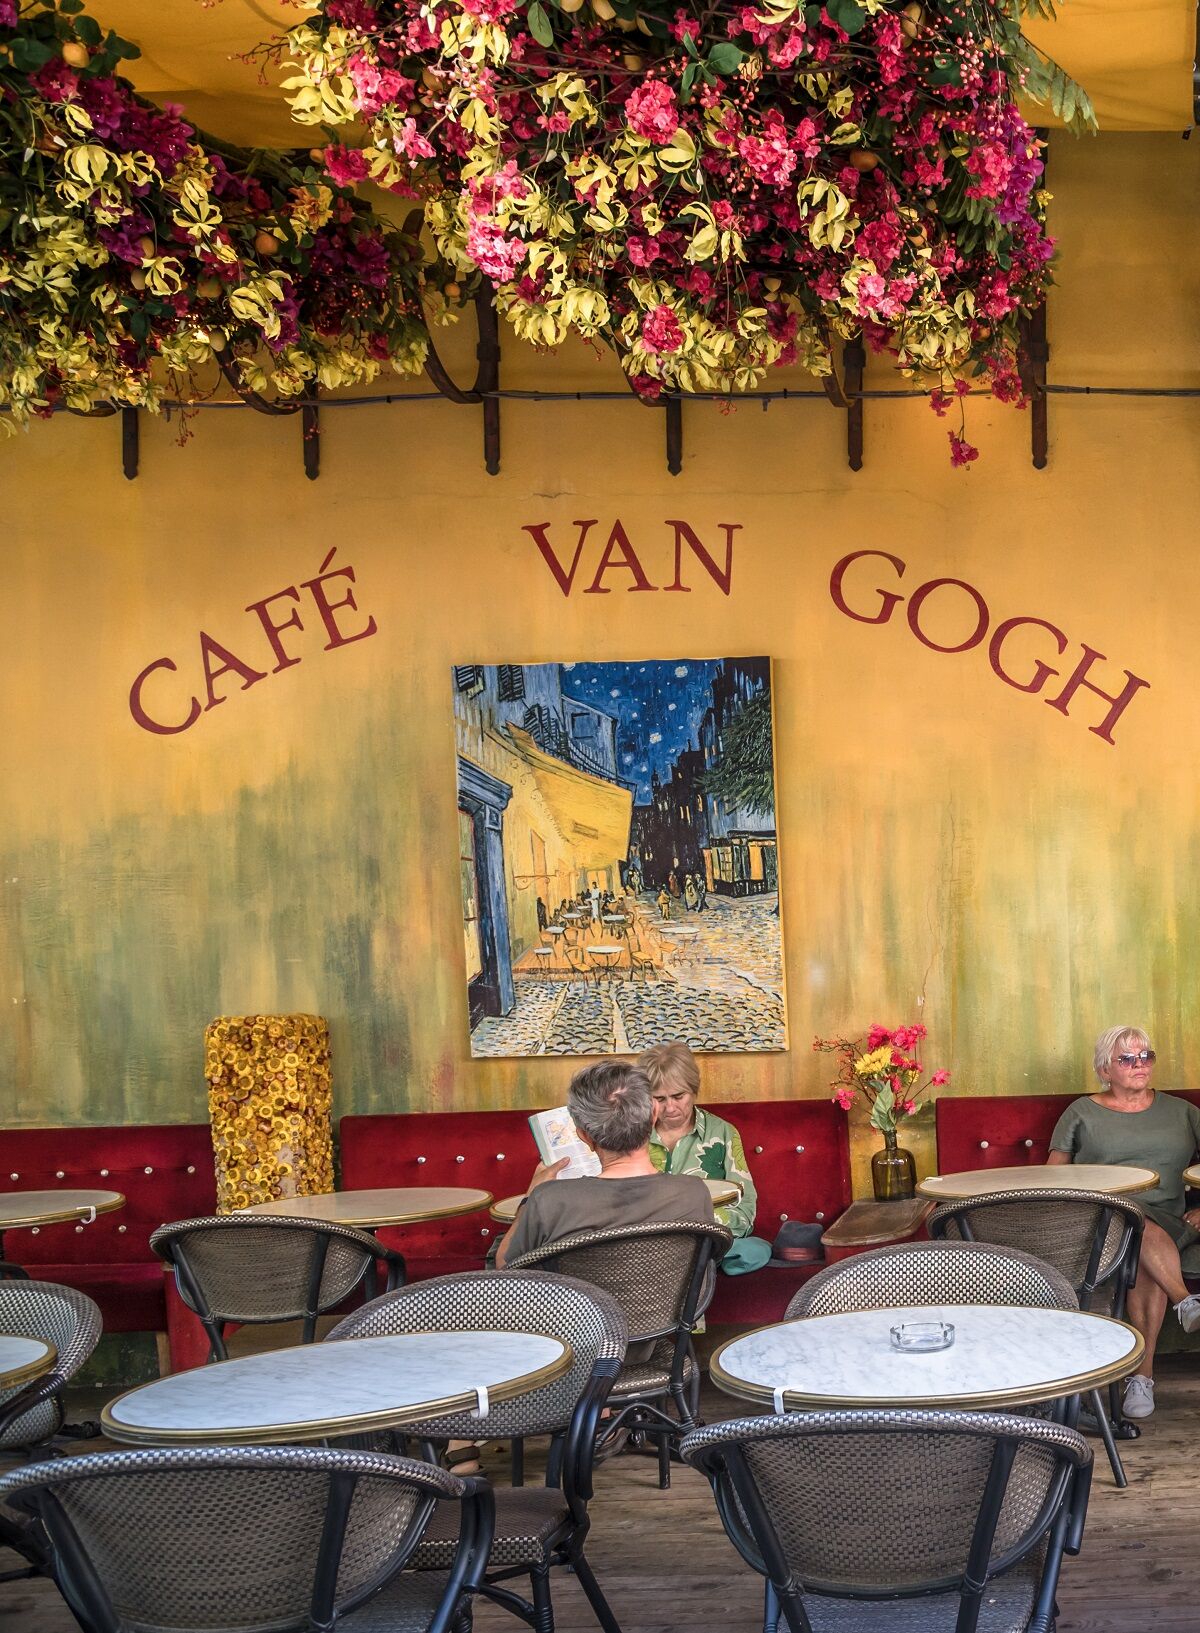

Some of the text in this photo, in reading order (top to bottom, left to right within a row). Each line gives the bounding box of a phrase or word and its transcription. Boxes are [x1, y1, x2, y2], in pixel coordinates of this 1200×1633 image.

[128, 518, 1151, 746] CAFÉ VAN GOGH
